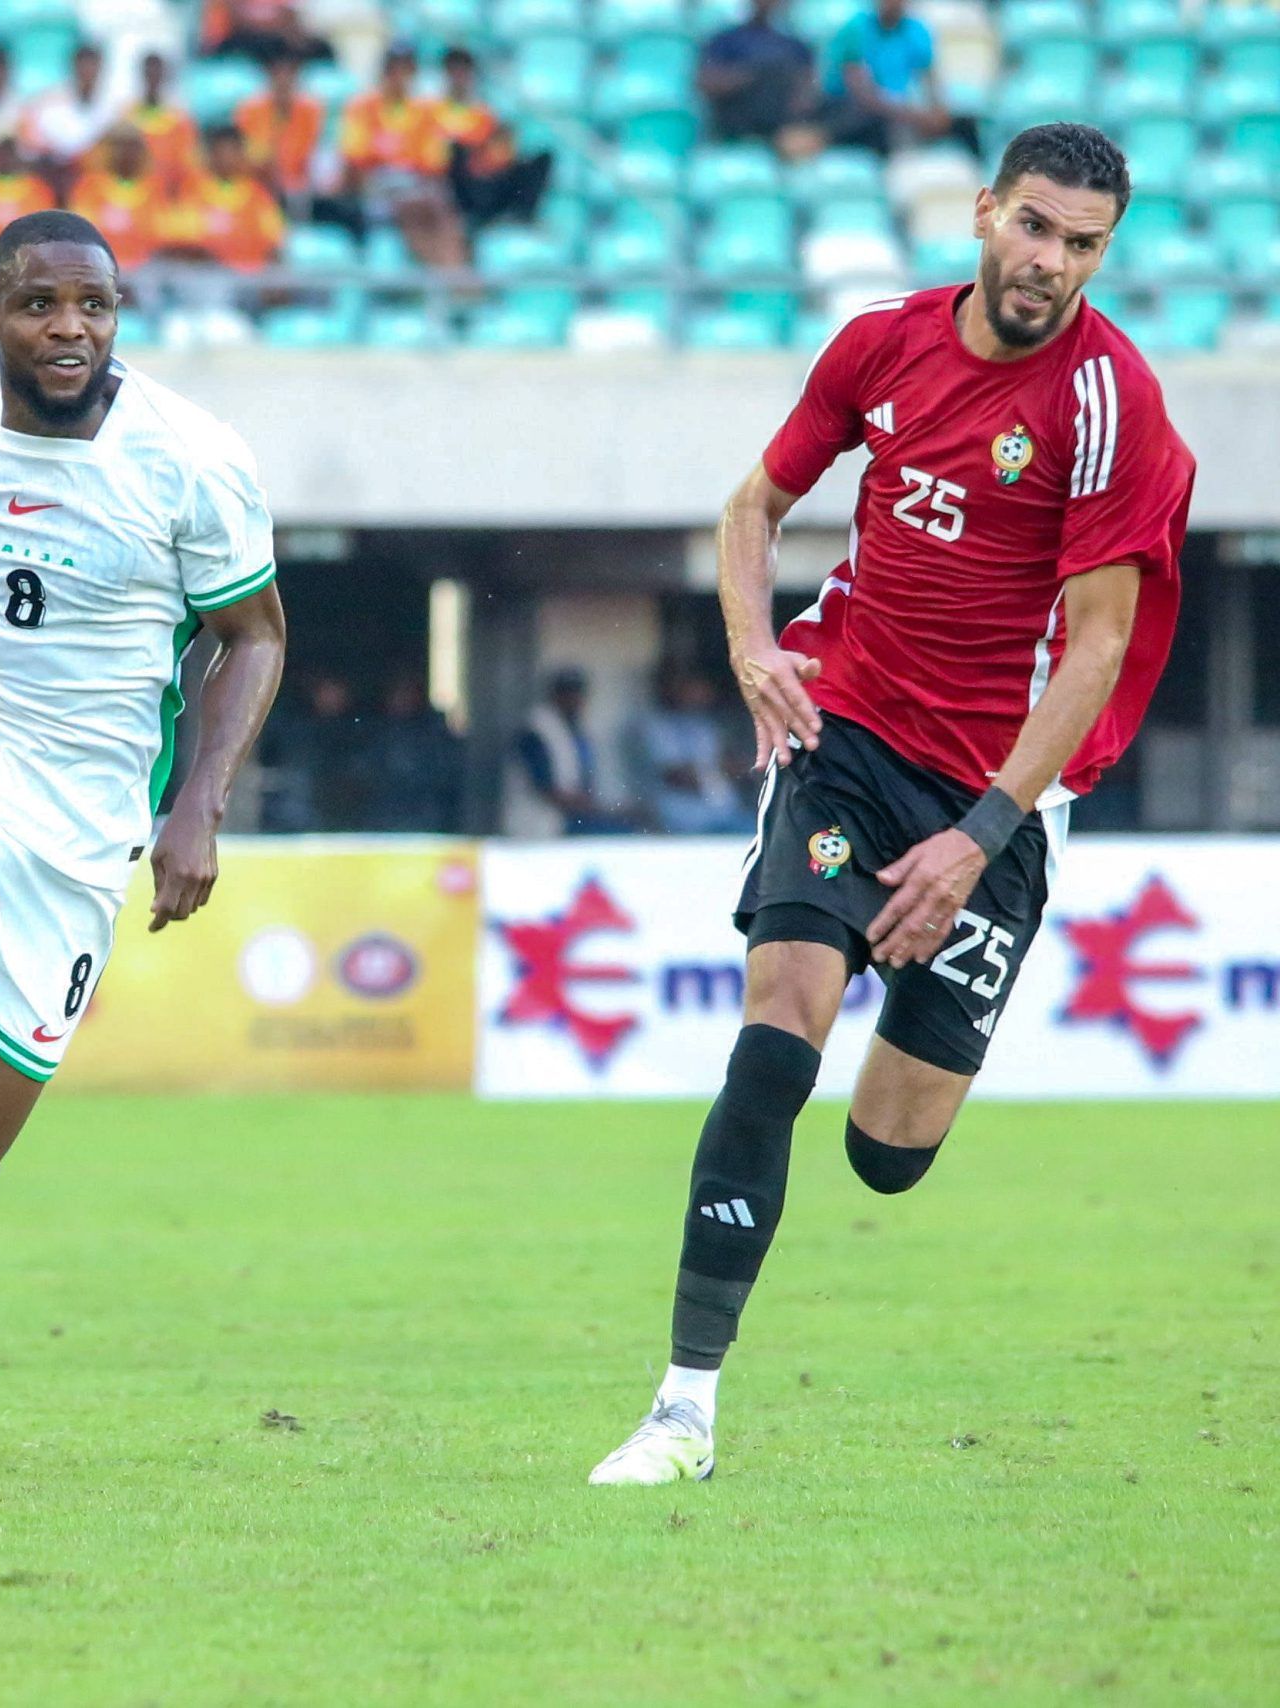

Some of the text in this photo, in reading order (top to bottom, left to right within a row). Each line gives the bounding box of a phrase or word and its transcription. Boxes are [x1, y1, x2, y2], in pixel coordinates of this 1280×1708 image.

[893, 465, 966, 543] 25
[5, 568, 47, 630] 8
[64, 952, 93, 1021] 8
[929, 907, 1015, 1001] 25
